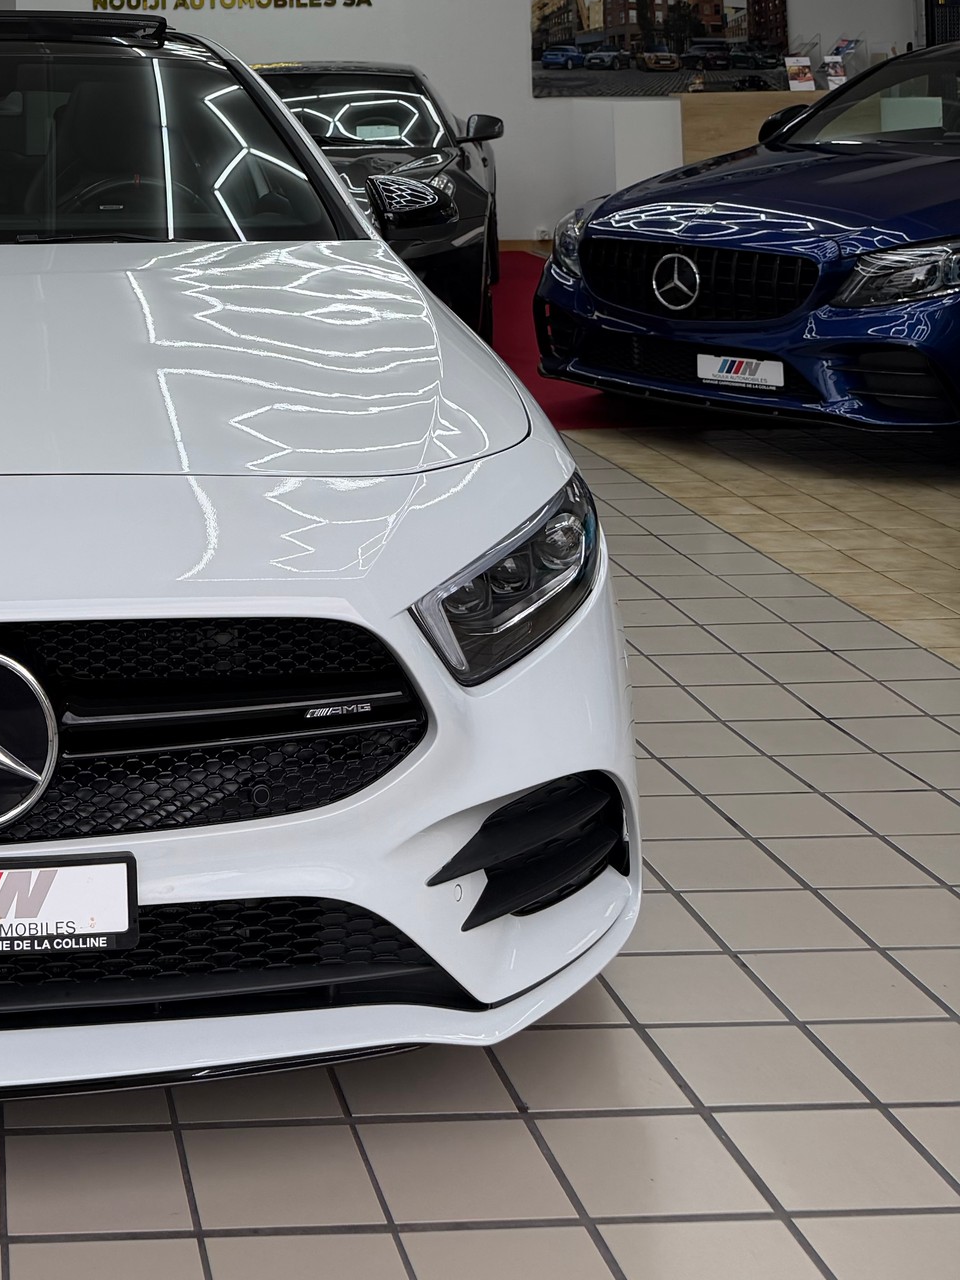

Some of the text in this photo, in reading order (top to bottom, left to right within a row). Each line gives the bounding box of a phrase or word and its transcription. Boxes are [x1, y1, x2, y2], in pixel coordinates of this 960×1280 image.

[14, 939, 31, 951] DE
[34, 938, 51, 950] LA
[53, 936, 107, 949] COLLINE
